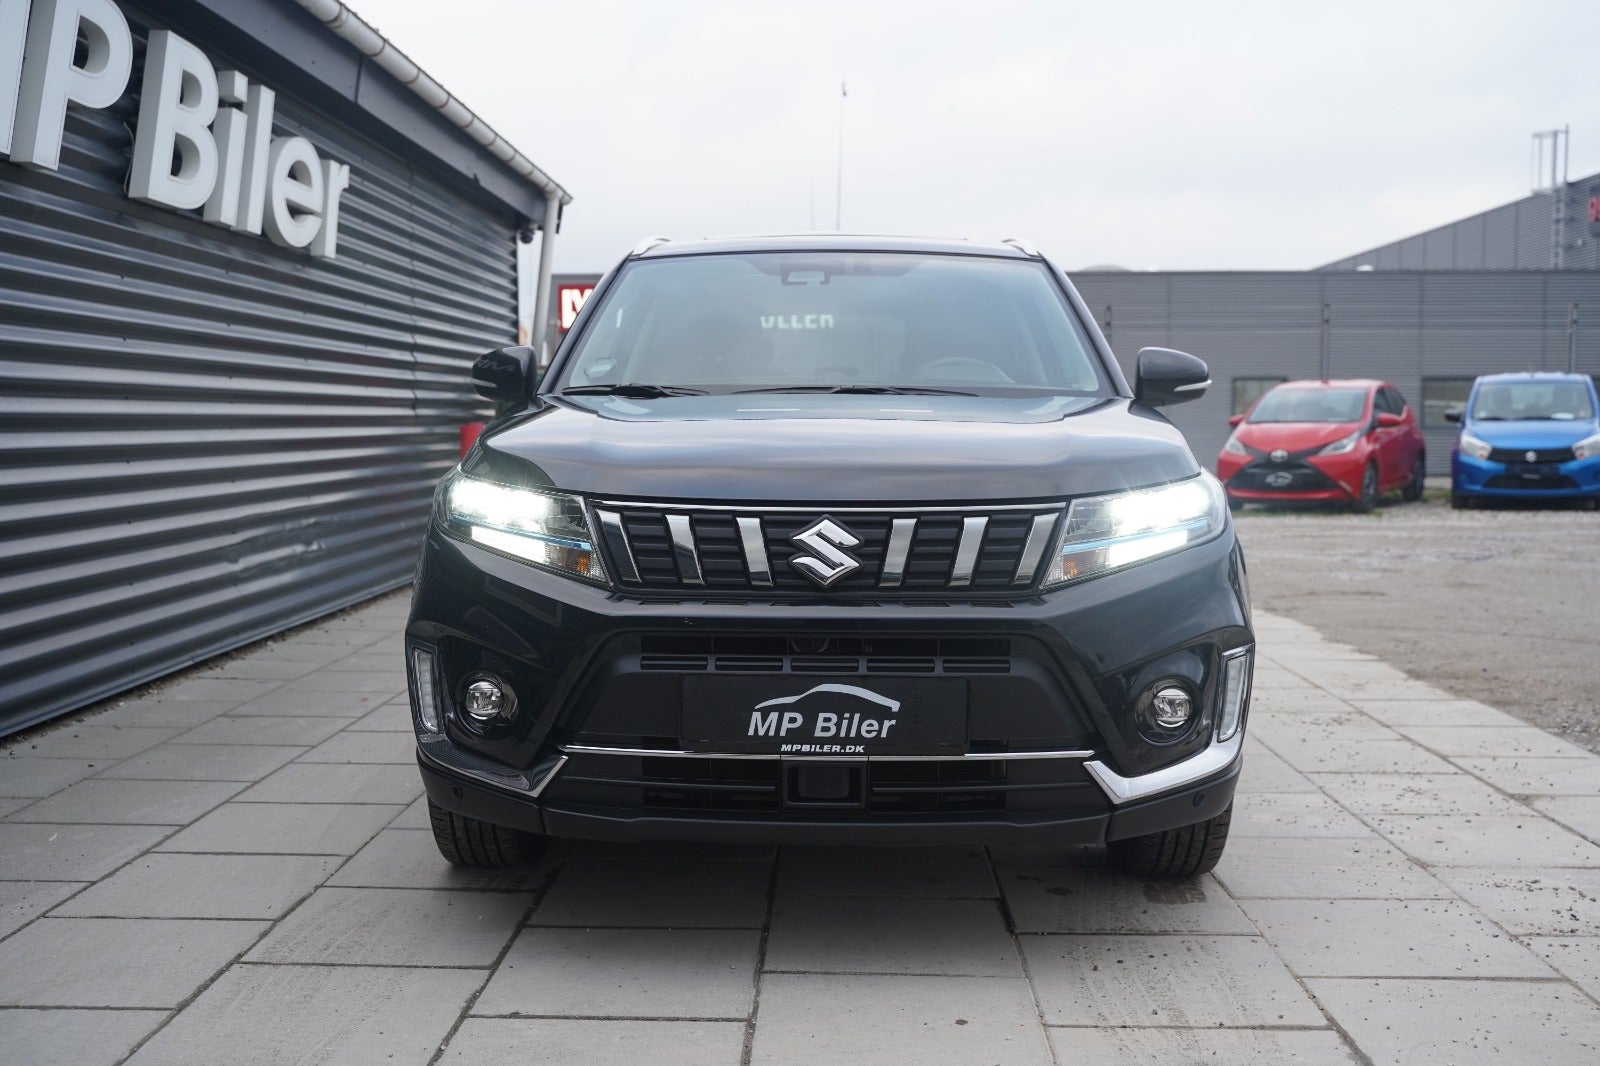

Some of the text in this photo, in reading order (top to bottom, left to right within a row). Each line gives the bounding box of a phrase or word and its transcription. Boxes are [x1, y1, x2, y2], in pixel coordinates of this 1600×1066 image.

[128, 29, 350, 259] Biler
[747, 711, 897, 739] MP Biler
[780, 743, 865, 753] MPBILER.DK
